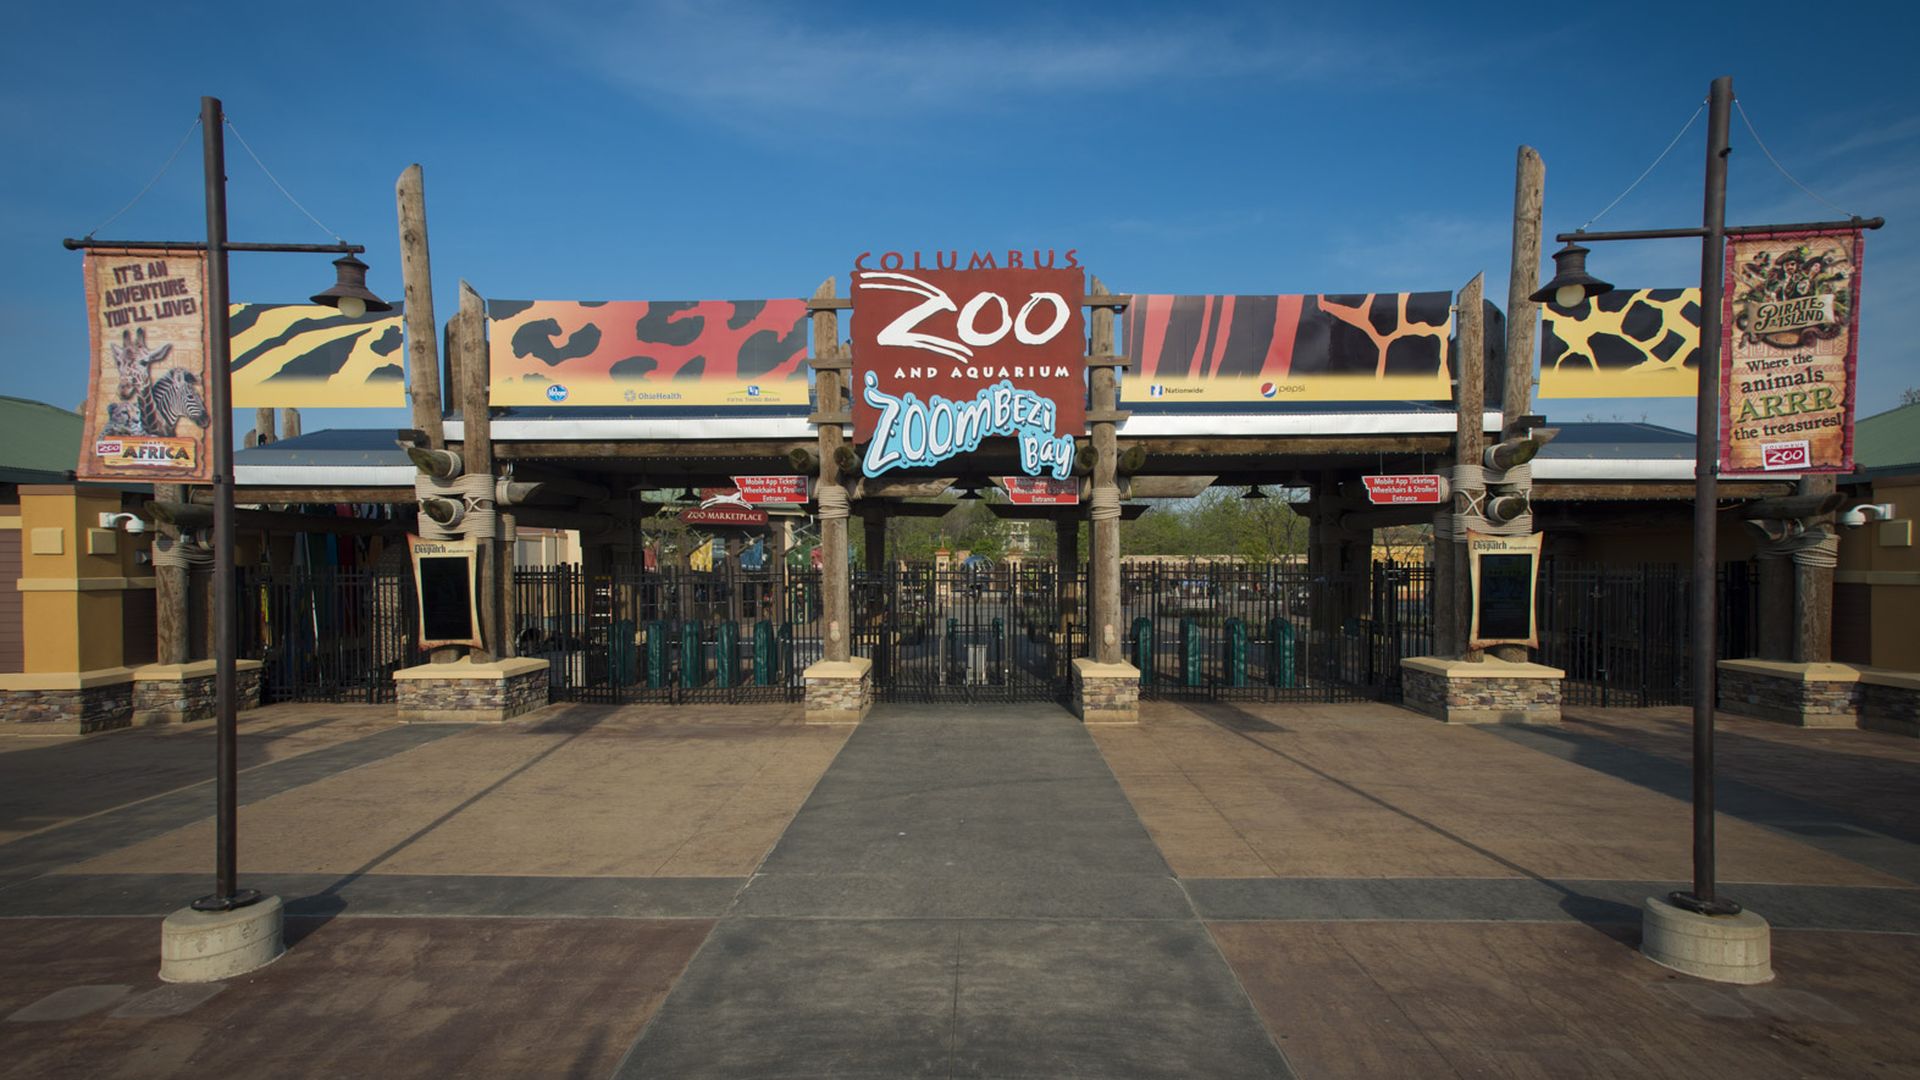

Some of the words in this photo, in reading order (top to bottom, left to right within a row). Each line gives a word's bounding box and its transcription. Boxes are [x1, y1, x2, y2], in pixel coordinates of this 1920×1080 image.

[855, 249, 1083, 270] COLUMBUS
[113, 263, 143, 285] IT'S
[147, 260, 168, 278] AN
[105, 277, 188, 308] ADVENTURE
[103, 305, 153, 328] YOU'LL
[155, 297, 196, 319] LOVE!
[859, 272, 1071, 363] ZOO
[1754, 297, 1825, 331] PIRATE
[1779, 309, 1824, 327] ISLAND
[1746, 357, 1789, 373] Where
[1793, 353, 1813, 365] the
[894, 366, 938, 378] AND
[951, 366, 1070, 379] AQUARIUM
[1741, 367, 1825, 394] animals
[638, 392, 682, 400] OhioHealth
[1278, 385, 1305, 394] pepsi
[1736, 387, 1836, 423] ARRR
[1733, 426, 1759, 441] the
[1763, 412, 1842, 437] treasures!
[122, 446, 189, 460] AFRICA
[1768, 450, 1803, 464] ZOO
[766, 478, 777, 486] App
[1395, 478, 1408, 486] App
[687, 511, 706, 519] ZOO
[707, 512, 762, 521] MARKETPLACE
[415, 544, 446, 554] Dispatch
[1473, 540, 1507, 551] Dispatch
